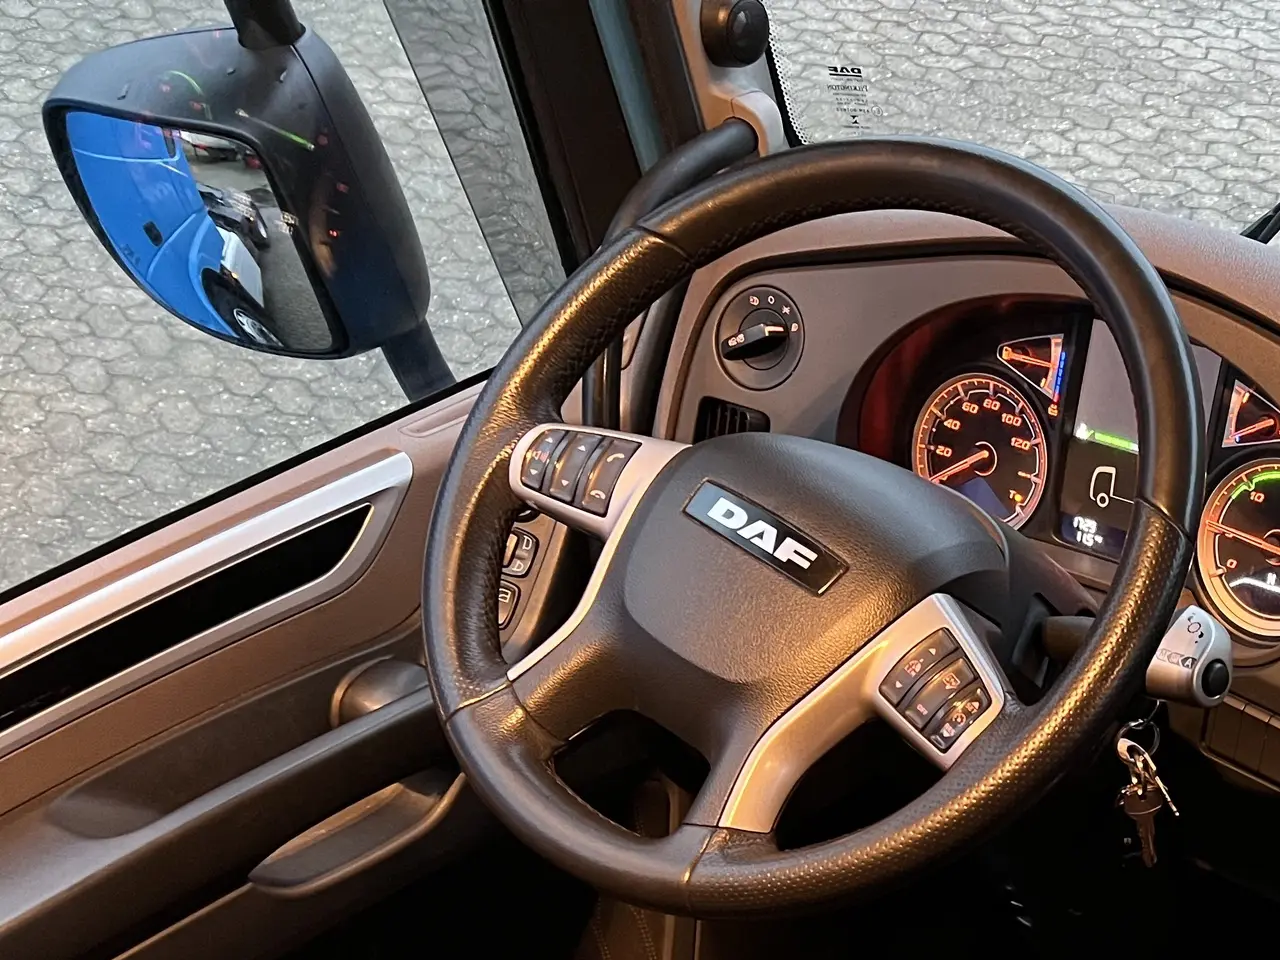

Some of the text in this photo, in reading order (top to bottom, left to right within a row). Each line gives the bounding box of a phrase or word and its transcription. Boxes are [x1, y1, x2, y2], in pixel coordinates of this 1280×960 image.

[962, 402, 979, 414] 60
[983, 398, 1000, 411] 80
[943, 418, 961, 431] 40
[1001, 412, 1022, 427] 100
[1010, 436, 1031, 451] 120
[935, 445, 953, 457] 20
[1249, 490, 1265, 503] 10
[707, 497, 818, 569] DAF
[1226, 558, 1238, 569] 0
[1266, 572, 1277, 586] N
[1184, 658, 1193, 668] A
